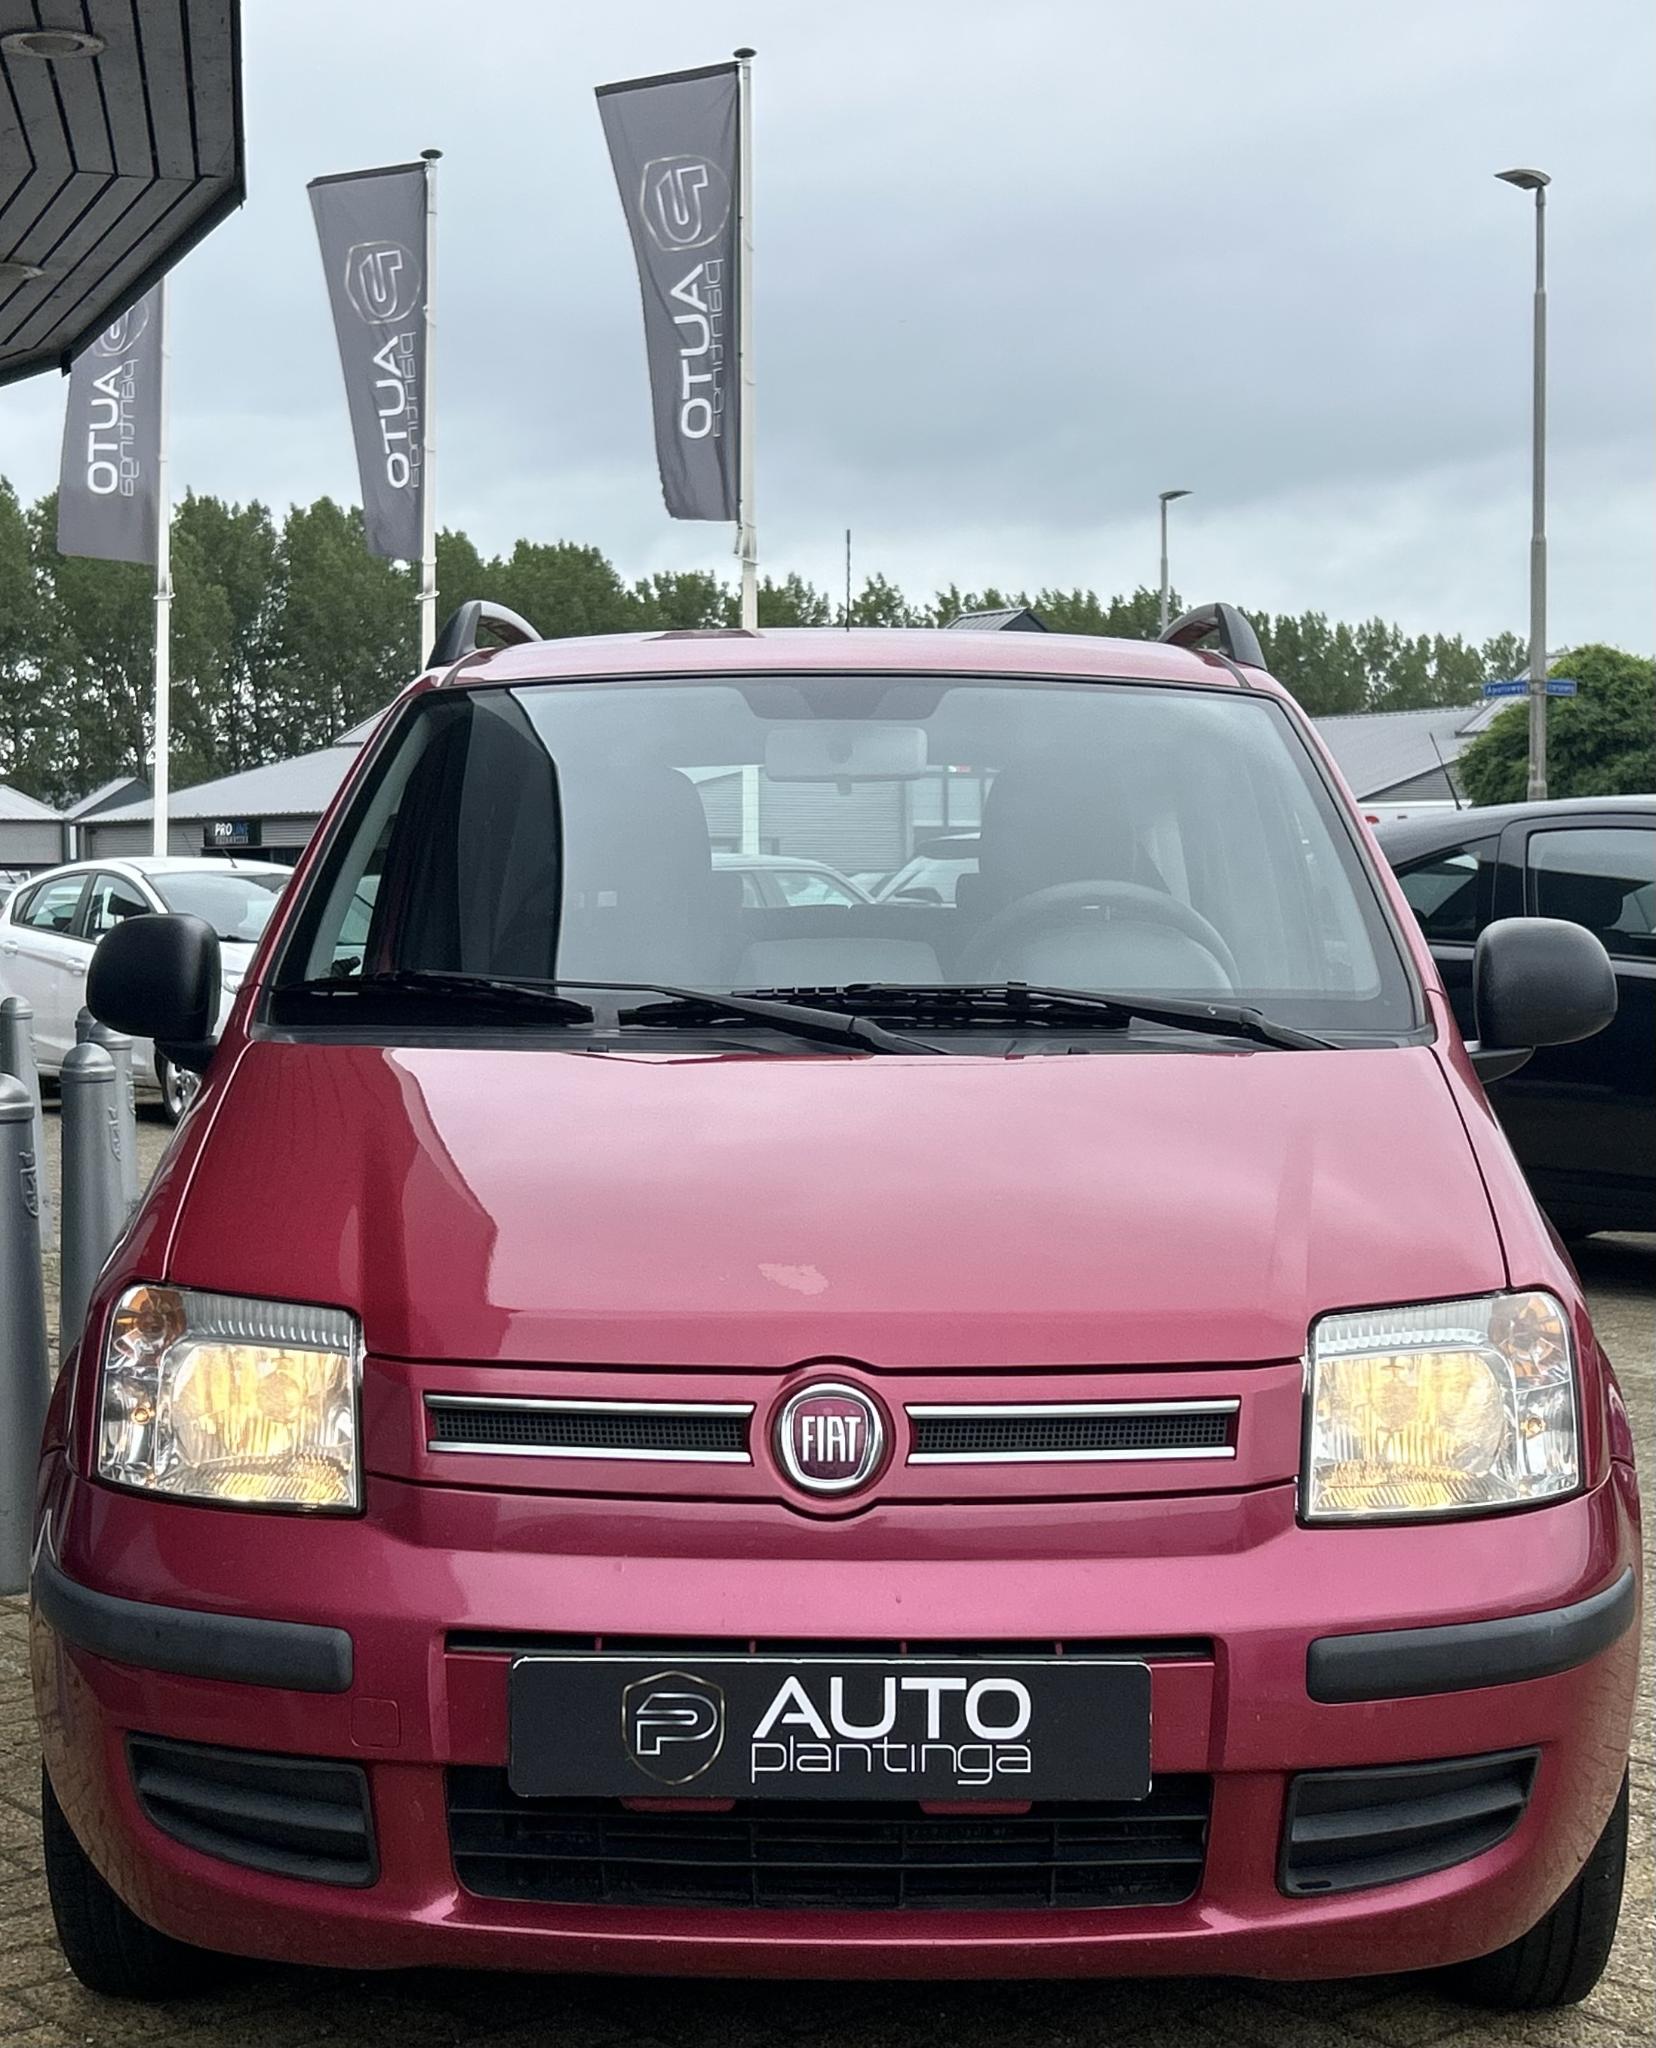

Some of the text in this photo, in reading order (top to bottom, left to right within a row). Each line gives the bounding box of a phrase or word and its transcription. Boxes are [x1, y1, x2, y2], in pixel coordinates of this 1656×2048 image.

[802, 1416, 861, 1462] FIAT
[752, 1676, 1031, 1739] AUTO
[751, 1735, 1031, 1785] plantinga
